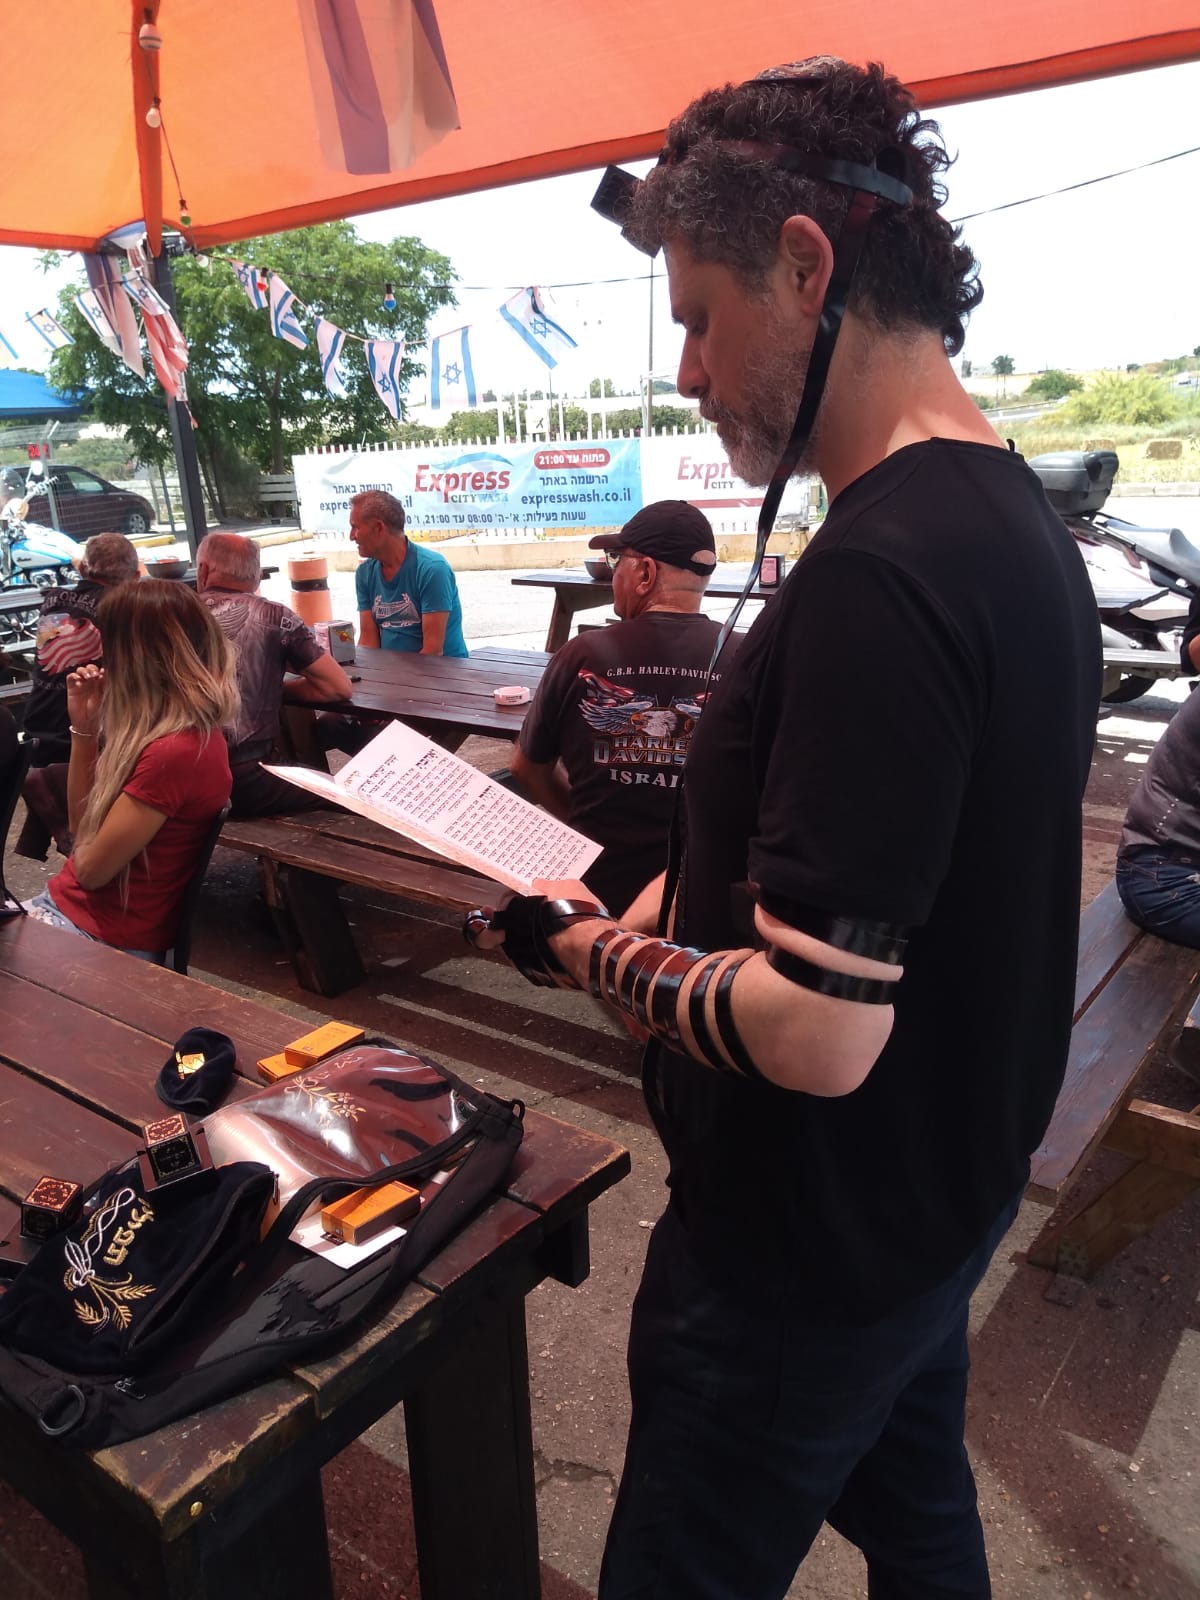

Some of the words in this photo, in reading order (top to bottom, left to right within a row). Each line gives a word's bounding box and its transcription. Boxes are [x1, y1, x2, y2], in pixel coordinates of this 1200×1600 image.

[538, 455, 565, 465] 21:00
[566, 456, 580, 464] עד
[582, 453, 605, 463] פתוח
[677, 456, 736, 490] Expr
[415, 464, 510, 503] Express
[539, 476, 568, 487] באתר
[570, 474, 609, 485] הרשמה
[711, 480, 735, 489] CITY
[333, 484, 357, 494] באתר
[450, 493, 477, 504] CITY
[520, 487, 632, 509] expresswash.co.il
[467, 514, 493, 523] 08:00
[561, 511, 586, 521] שעות
[606, 667, 635, 677] G.B.R.
[614, 736, 688, 751] HARLE
[593, 740, 688, 765] DAVIDS
[103, 1197, 155, 1266] תפילין
